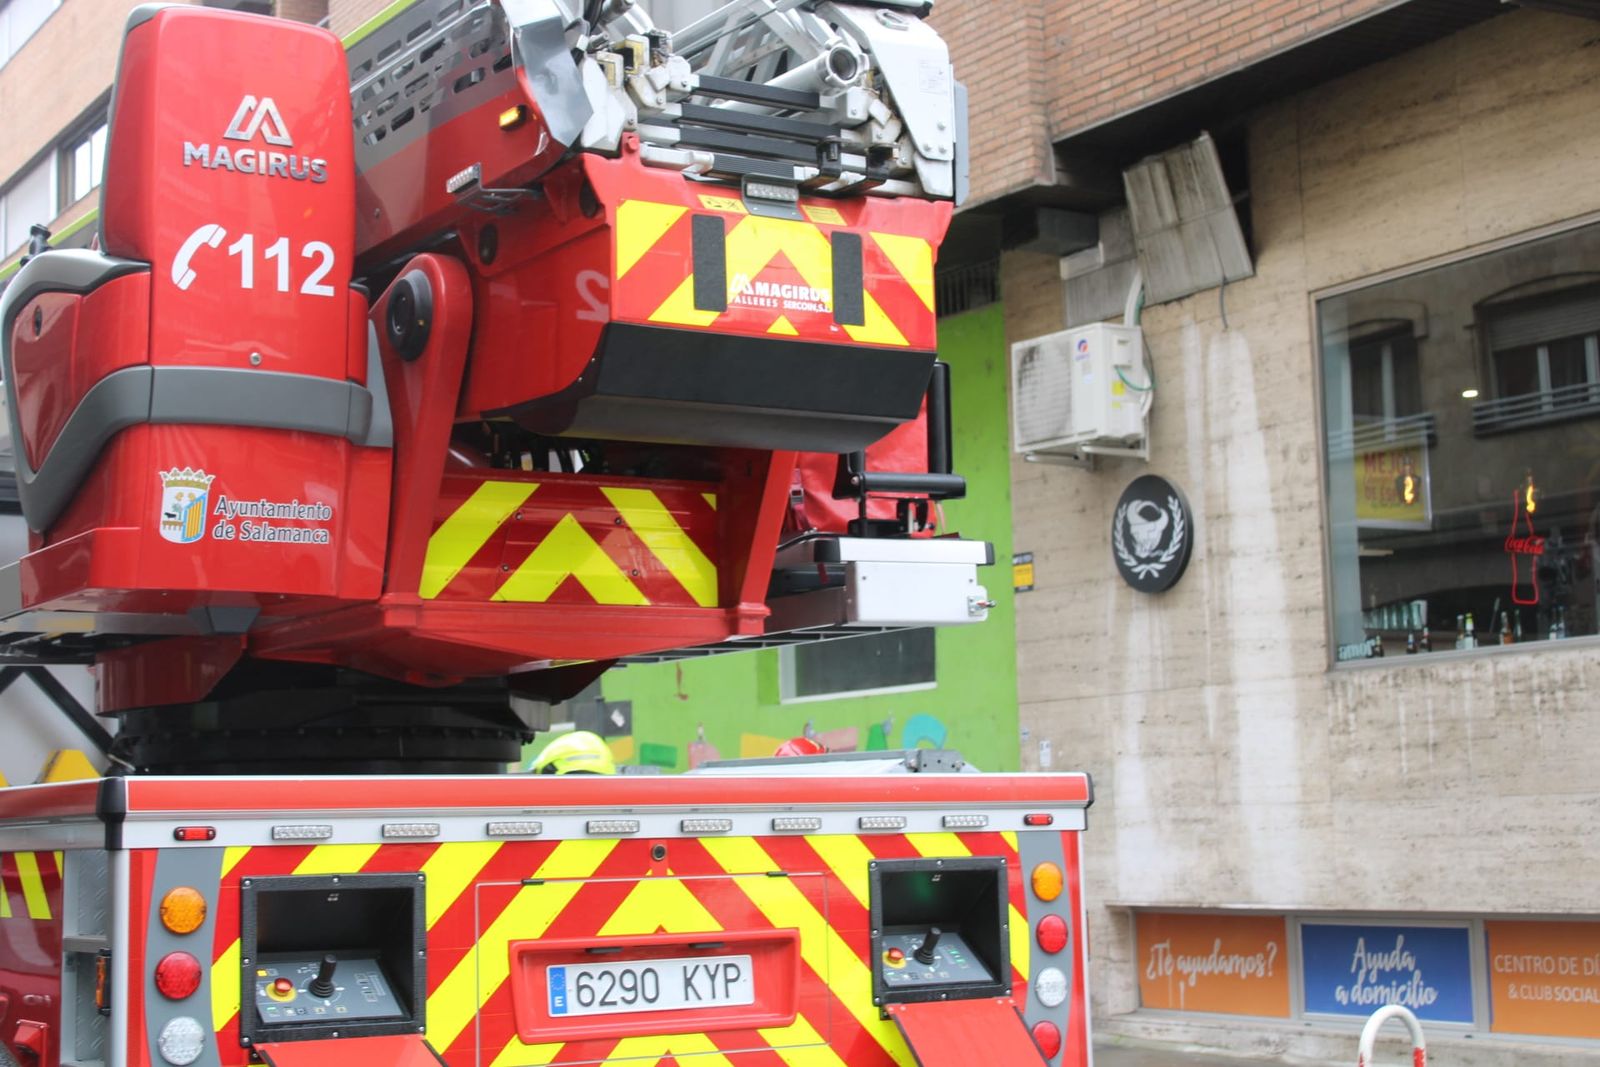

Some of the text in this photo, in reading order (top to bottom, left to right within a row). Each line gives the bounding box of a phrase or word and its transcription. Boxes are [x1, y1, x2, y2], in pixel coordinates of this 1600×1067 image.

[183, 141, 328, 183] MAGIRUS
[228, 233, 335, 297] 112
[755, 281, 830, 302] MAGIRUS
[214, 495, 332, 519] Ayuntamiento
[213, 521, 330, 544] de Salamanca
[1177, 937, 1278, 987] ayudamos?
[1351, 934, 1416, 984] Ayuda
[1494, 954, 1555, 975] CENTRO
[1558, 956, 1578, 976] DE
[576, 963, 741, 1007] 6290 KYP
[1335, 969, 1439, 1009] a domicilio
[1508, 983, 1600, 1004] & CLUB SOCIAL
[554, 996, 564, 1007] E
